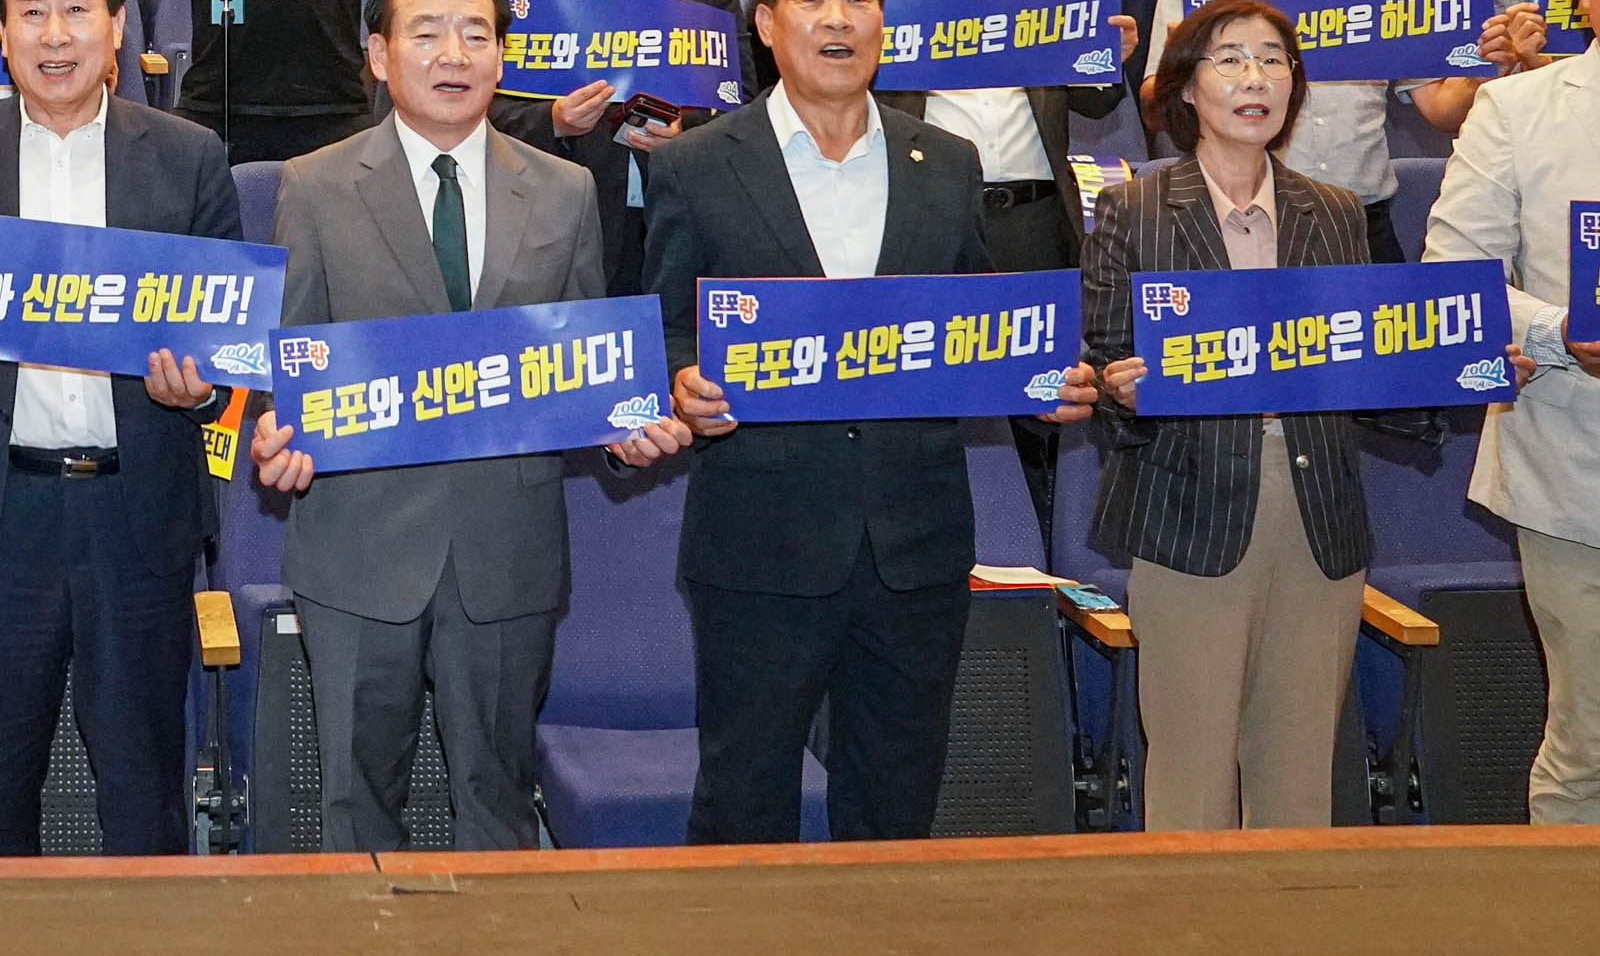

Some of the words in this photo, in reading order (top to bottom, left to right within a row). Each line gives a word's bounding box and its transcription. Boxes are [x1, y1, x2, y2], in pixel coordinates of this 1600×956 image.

[503, 33, 580, 69] 목포와
[585, 30, 662, 68] 신안은
[668, 28, 728, 68] 하나다!
[929, 14, 1008, 59] 신안은
[1014, 0, 1100, 48] 하나다!
[1295, 4, 1373, 50] 신안은
[22, 274, 126, 323] 신안은
[133, 273, 254, 325] 하나다!
[724, 335, 828, 391] 목포와
[836, 320, 935, 380] 신안은
[944, 303, 1055, 365] 하나다!
[1161, 326, 1260, 384] 목포와
[1268, 310, 1363, 371] 신안은
[1373, 293, 1483, 355] 하나다!
[301, 376, 404, 439] 목포와
[412, 354, 511, 421] 신안은
[519, 330, 634, 398] 하나다!
